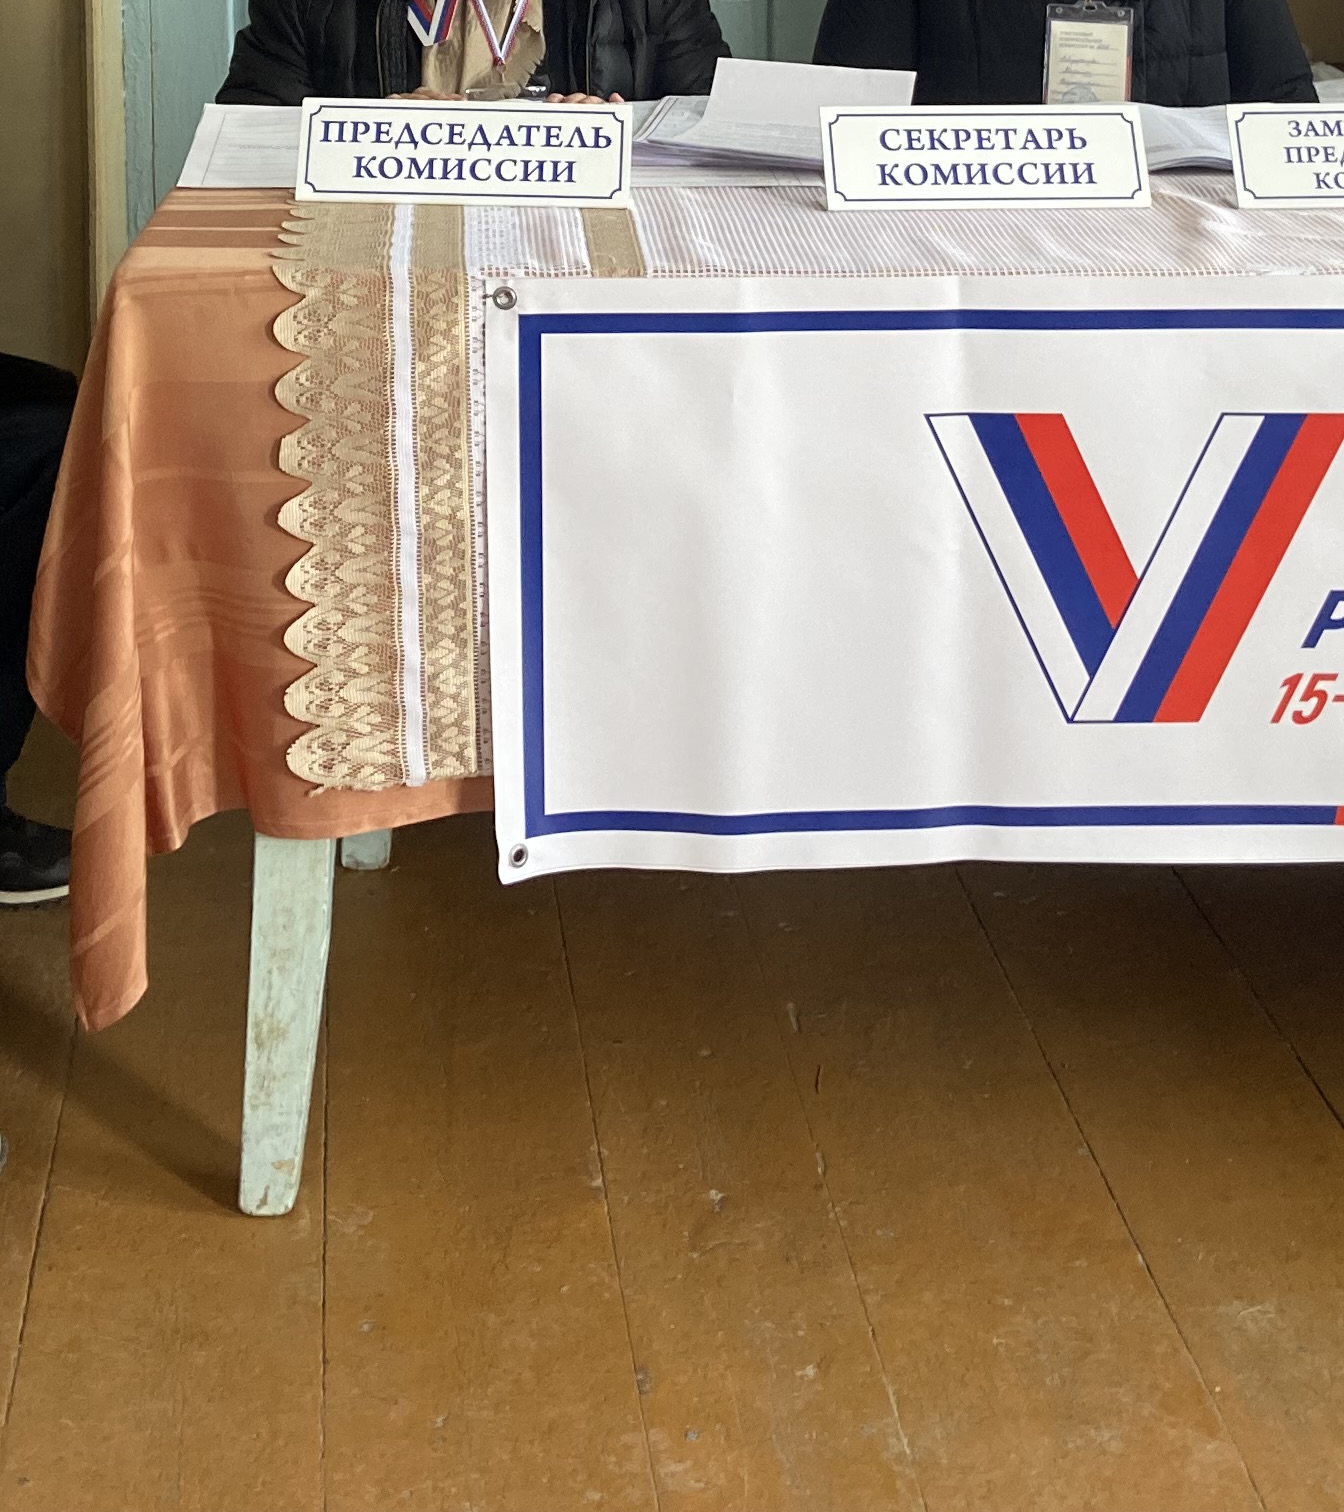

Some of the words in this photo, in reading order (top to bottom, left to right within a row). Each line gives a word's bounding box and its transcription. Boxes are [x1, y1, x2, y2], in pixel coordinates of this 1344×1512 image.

[319, 120, 613, 152] ПРЕДСЕДАТЕЛЬ
[879, 128, 1088, 151] СЕКРЕТАРЬ
[353, 155, 577, 184] КОМИССИИ
[876, 162, 1098, 187] КОМИССИИ
